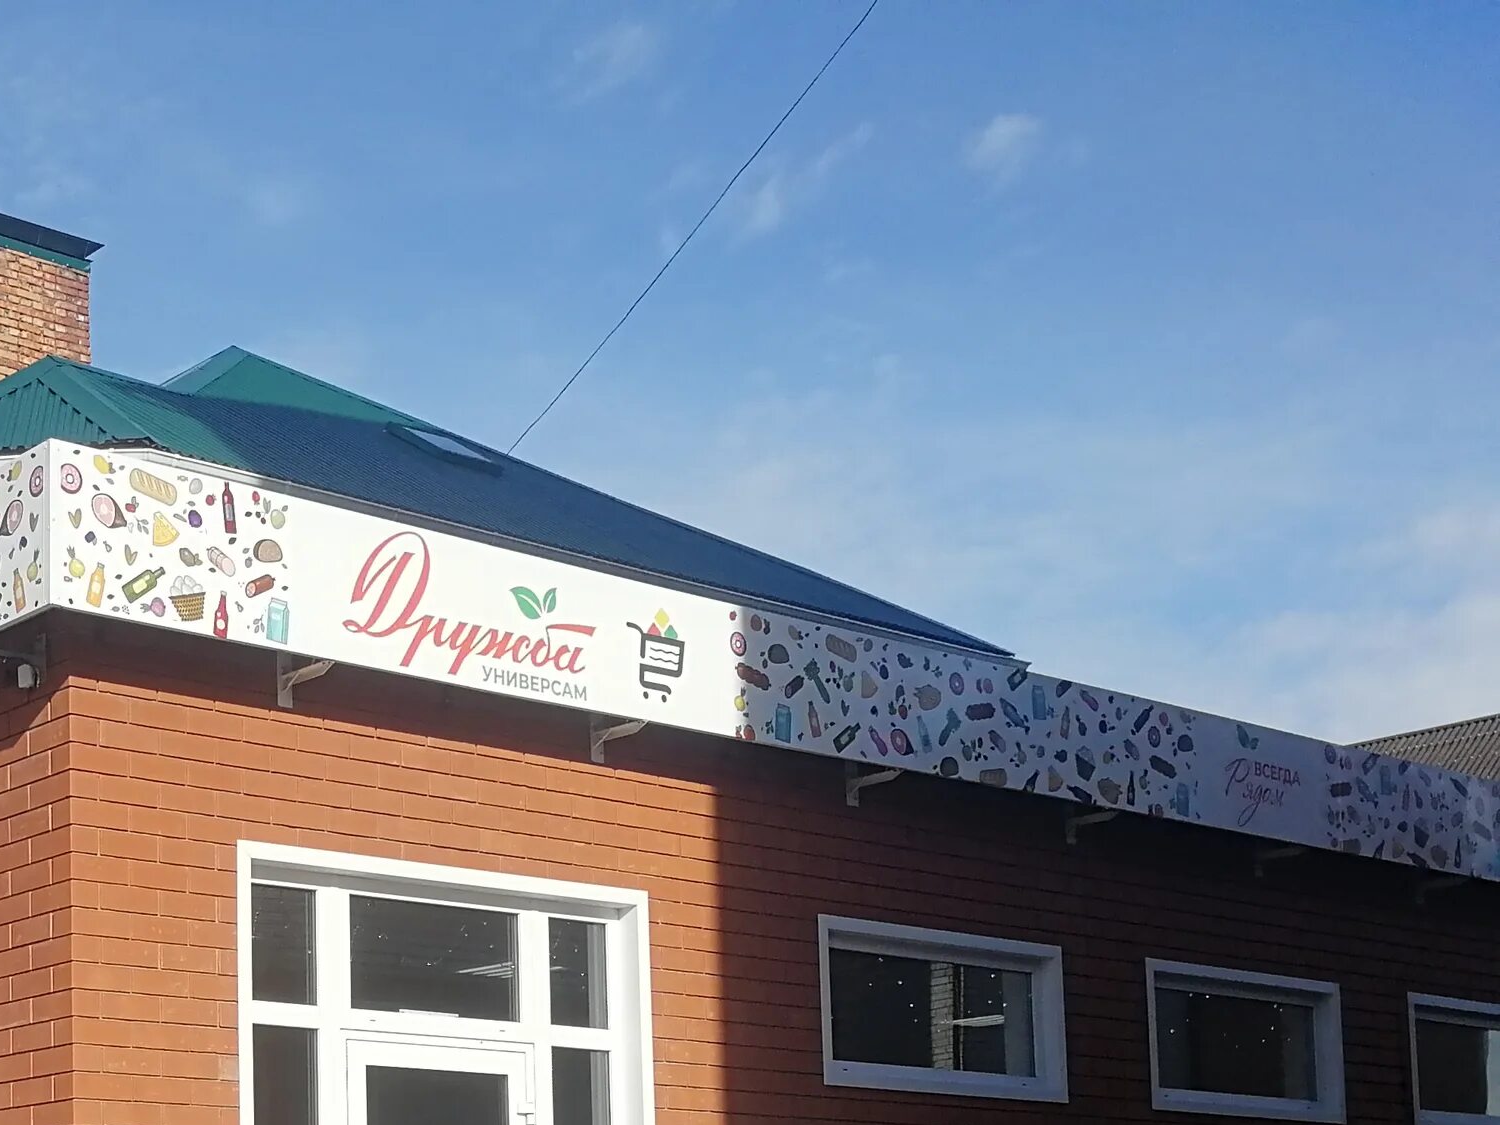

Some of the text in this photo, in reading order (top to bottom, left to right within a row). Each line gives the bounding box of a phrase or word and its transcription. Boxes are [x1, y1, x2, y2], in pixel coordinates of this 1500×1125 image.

[342, 531, 596, 675] Дружба
[482, 664, 588, 701] УНИВЕРСАМ
[1254, 761, 1301, 786] ВСЕГДА
